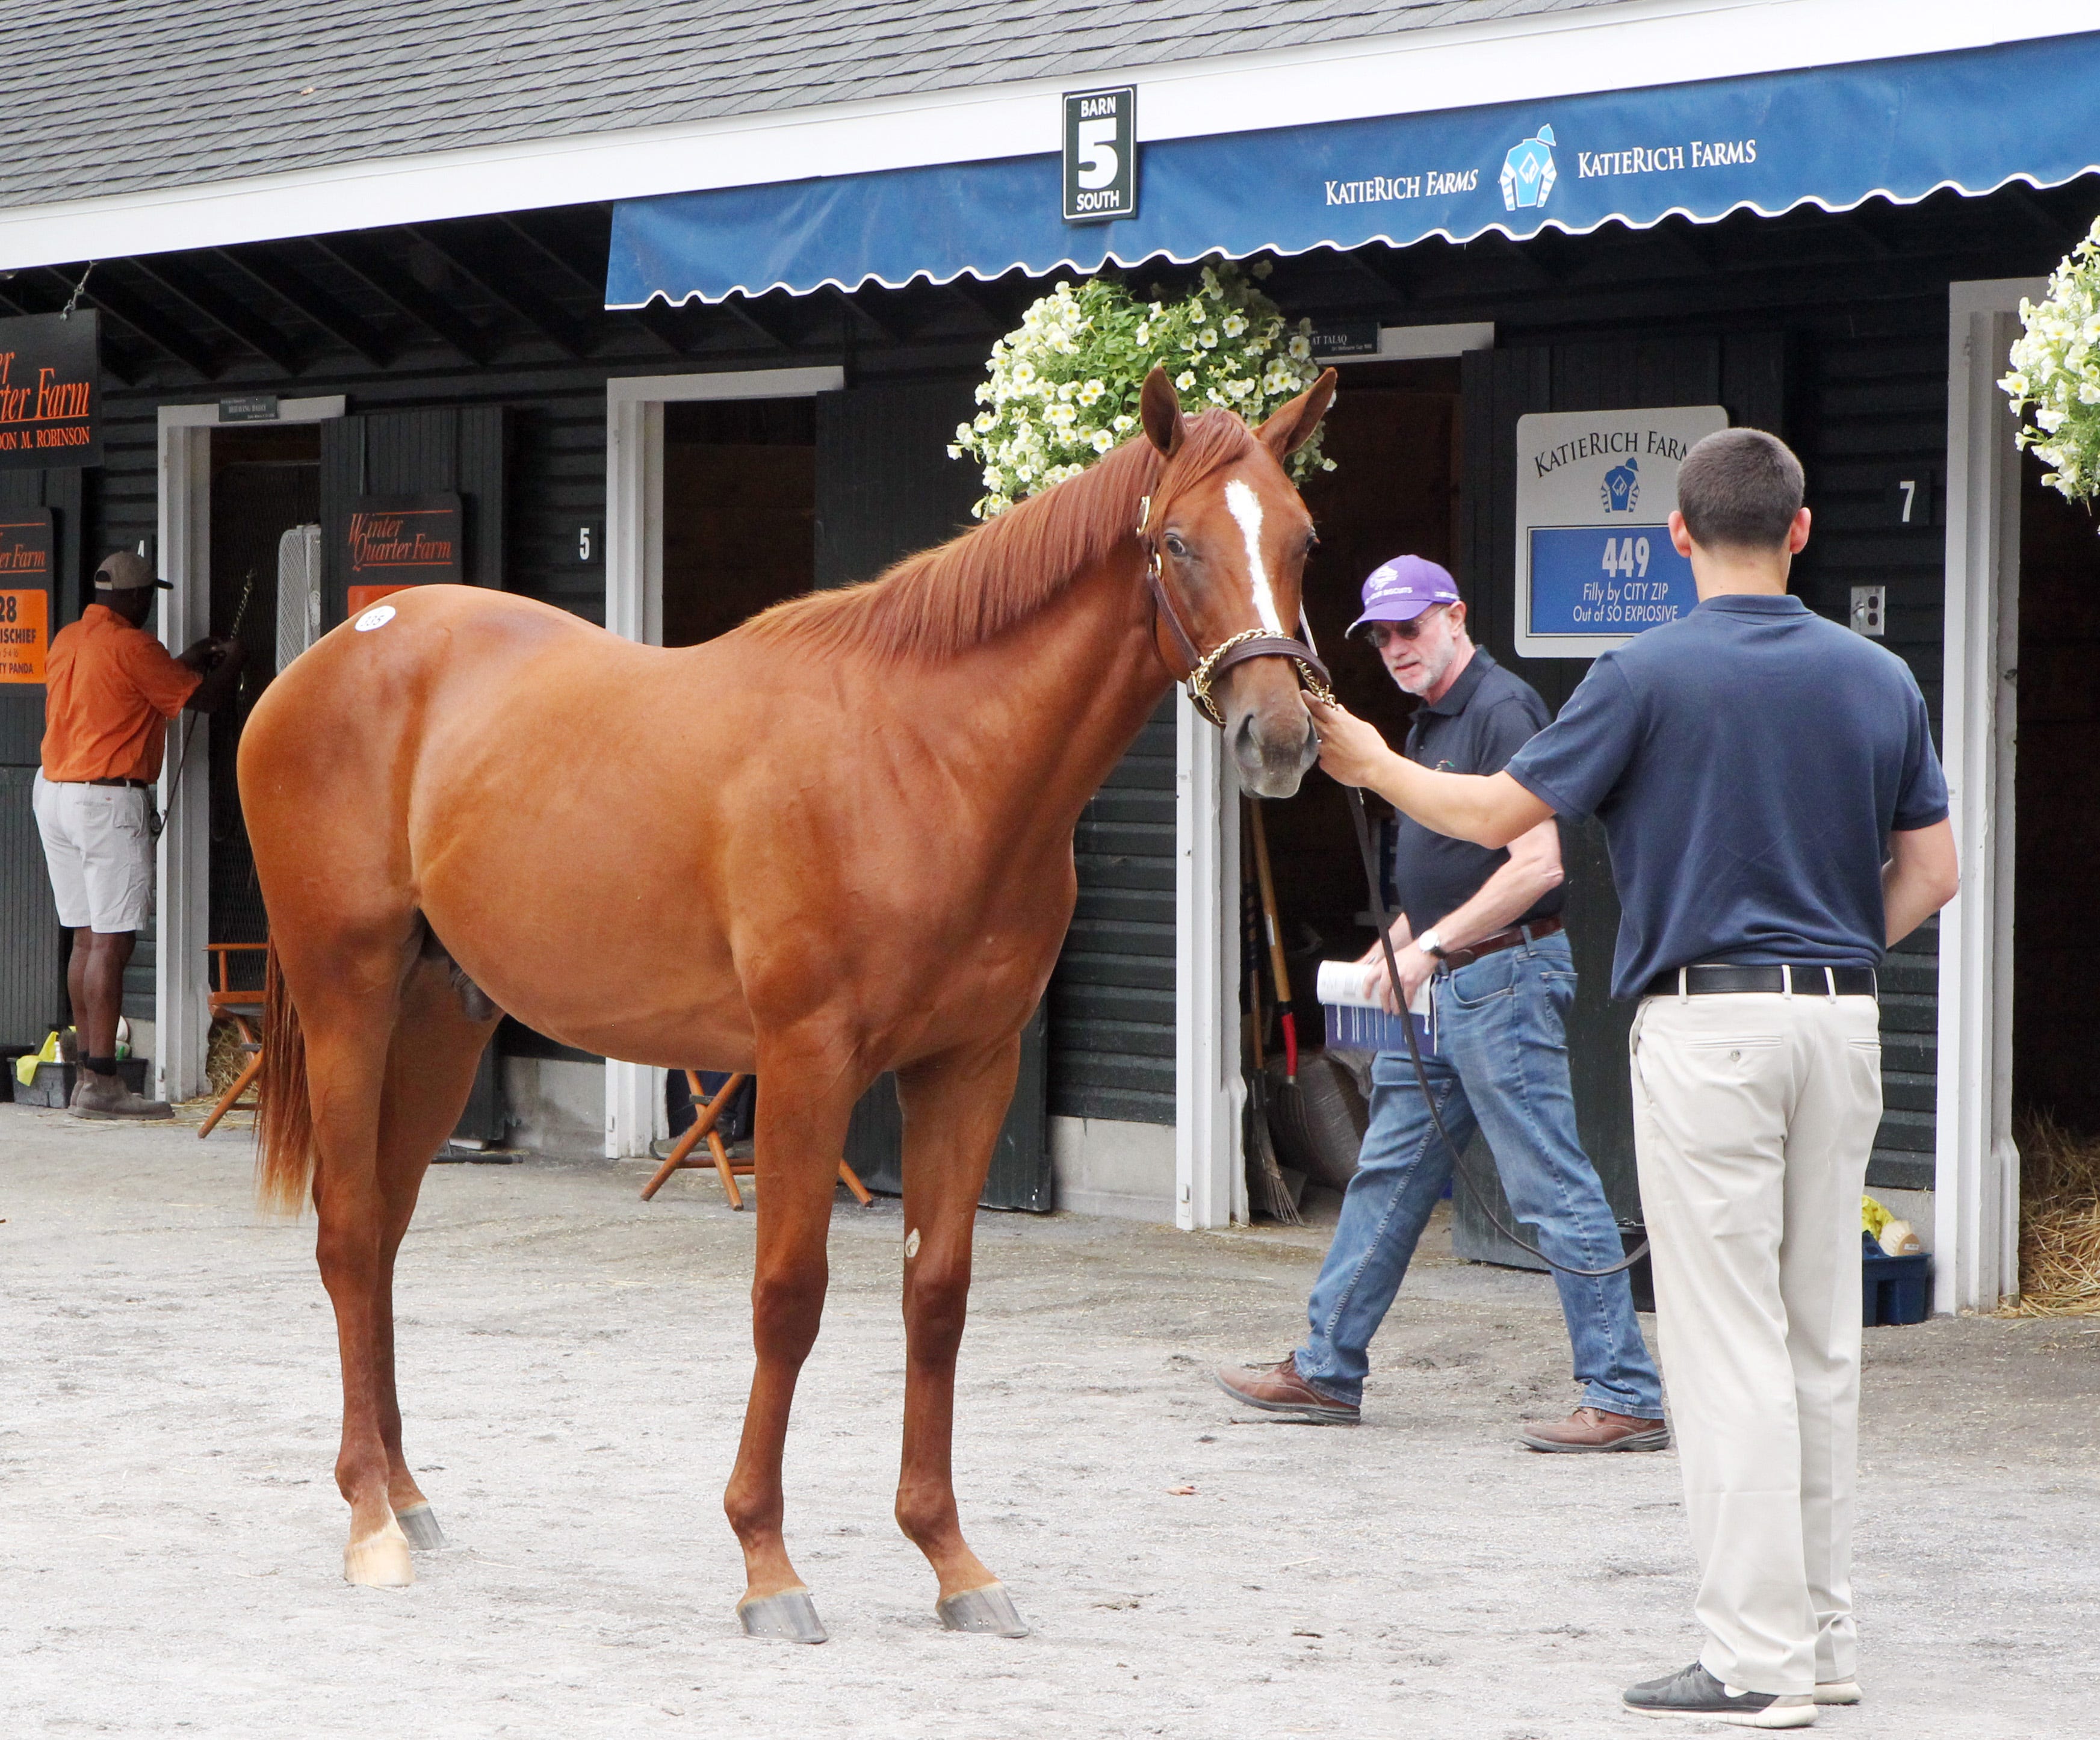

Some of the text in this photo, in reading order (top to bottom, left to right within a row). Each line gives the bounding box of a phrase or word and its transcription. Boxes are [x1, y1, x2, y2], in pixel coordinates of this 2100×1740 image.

[1080, 96, 1117, 117] BARN
[1078, 117, 1119, 190] 5
[1076, 190, 1120, 211] SOUTH
[1323, 333, 1348, 345] TALAQ
[34, 367, 90, 420] Farm
[21, 430, 33, 449] M.
[36, 426, 90, 448] ROBINSON
[1899, 480, 1916, 523] 7
[348, 512, 404, 545] Winter
[12, 543, 46, 568] Farm
[352, 533, 452, 571] Quarter Farm
[579, 527, 590, 560] 5
[1602, 536, 1650, 578] 449
[1583, 581, 1669, 606] Filly by CITY ZIP
[1573, 604, 1679, 622] Out of SO EXPLOSIVE
[9, 662, 34, 674] PANDA
